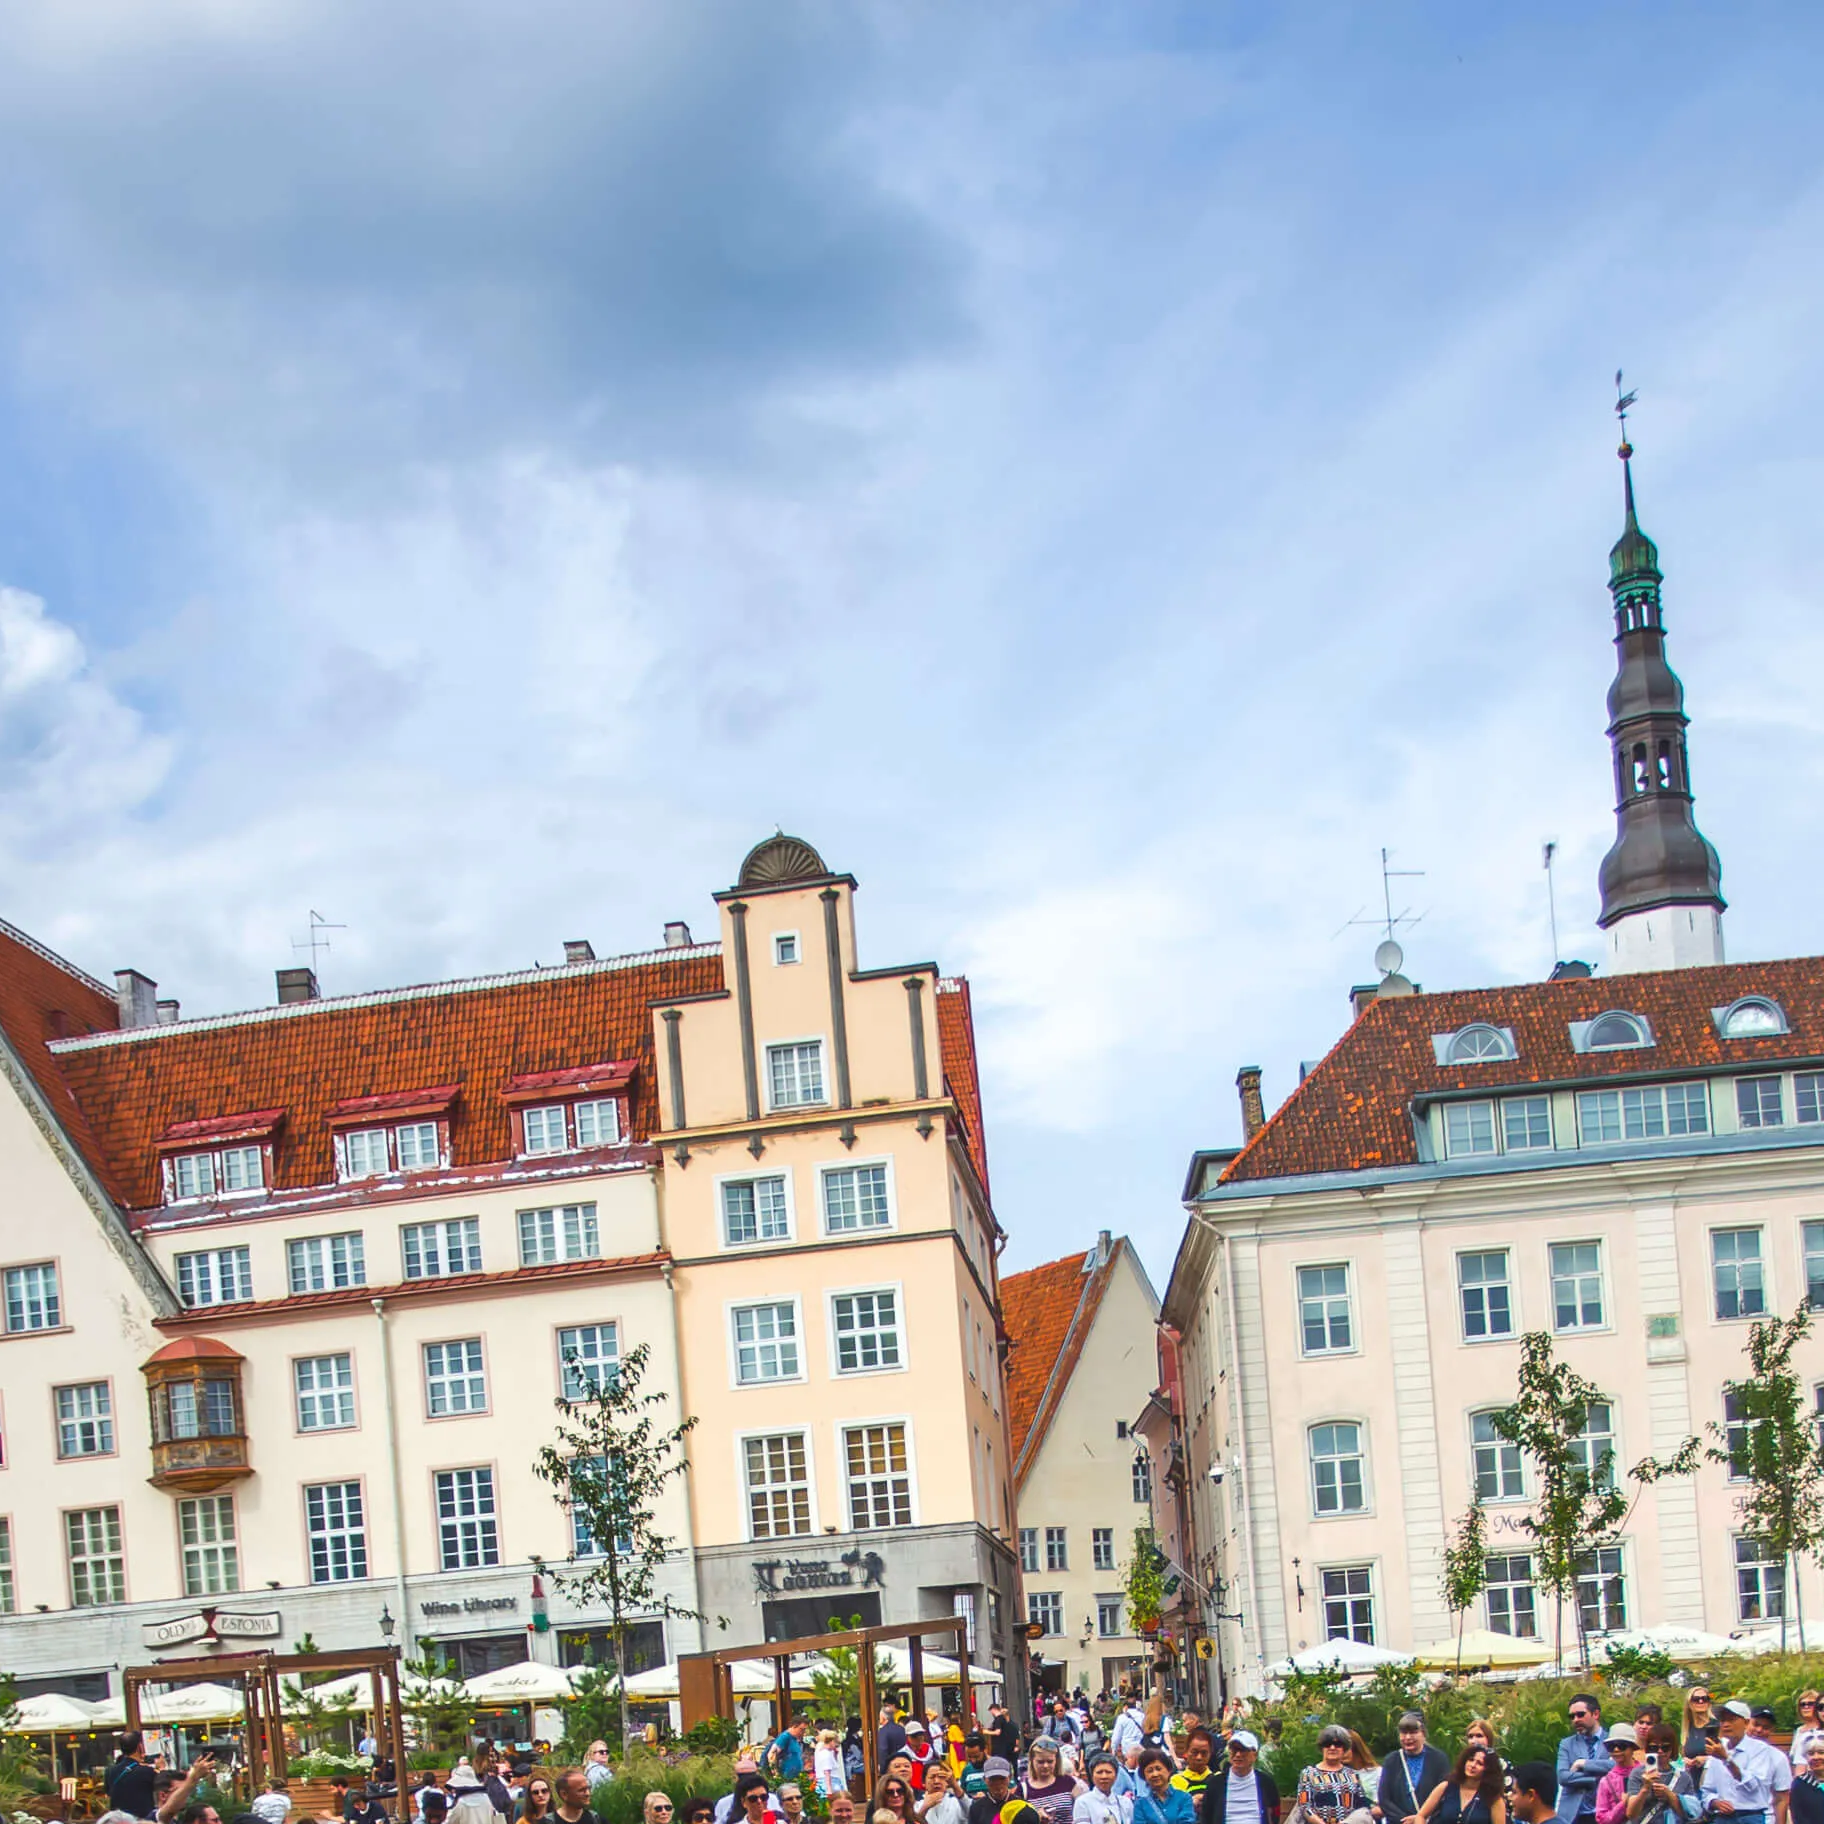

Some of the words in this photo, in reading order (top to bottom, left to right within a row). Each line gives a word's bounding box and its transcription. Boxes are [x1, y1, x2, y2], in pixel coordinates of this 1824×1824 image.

[421, 1601, 461, 1616] Wine
[463, 1597, 517, 1613] Library
[158, 1623, 185, 1640] OLD
[221, 1619, 274, 1632] ESTONIA
